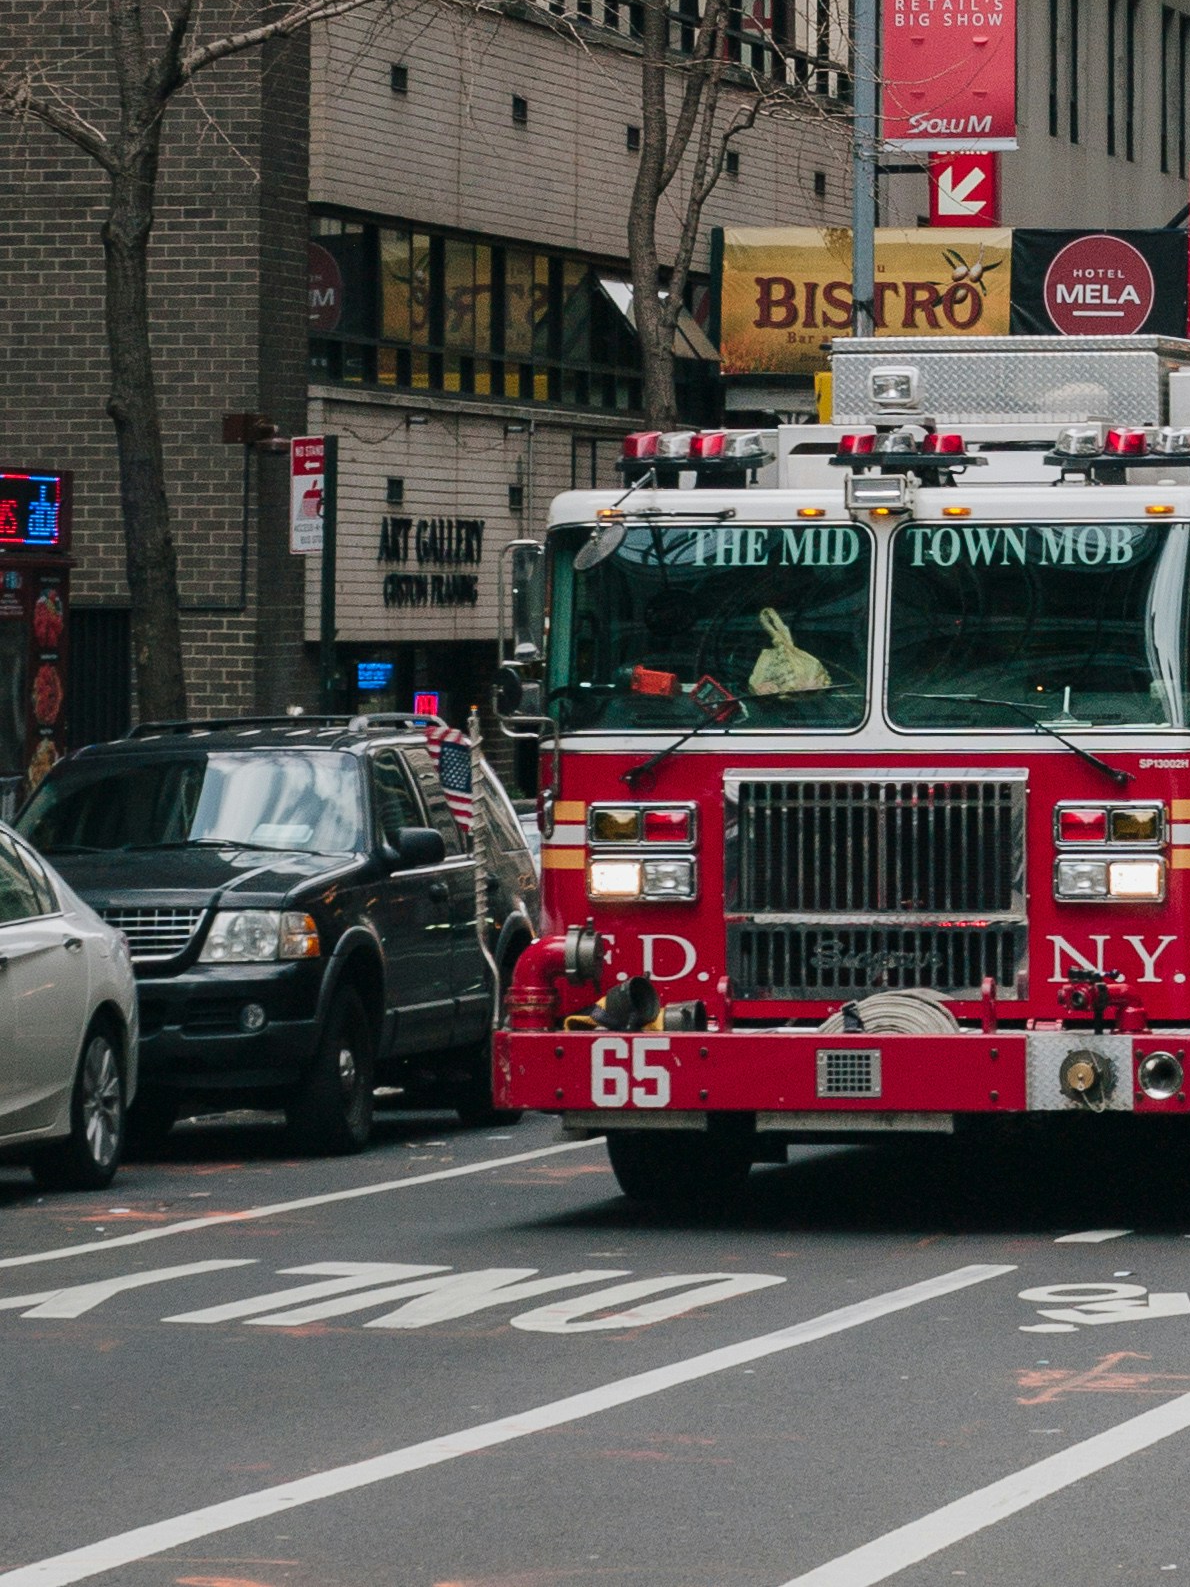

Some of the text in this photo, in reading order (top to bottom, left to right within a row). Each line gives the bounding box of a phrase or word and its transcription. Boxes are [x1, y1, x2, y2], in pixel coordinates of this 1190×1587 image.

[894, 13, 1003, 27] BIG SHOW
[1073, 269, 1126, 279] HOTEL
[753, 276, 984, 330] BISTRO
[1056, 284, 1141, 305] MELA
[688, 527, 860, 566] THE MID
[906, 526, 1134, 566] TOWN MOB
[1138, 758, 1190, 769] SP13002H
[590, 1036, 672, 1108] 65
